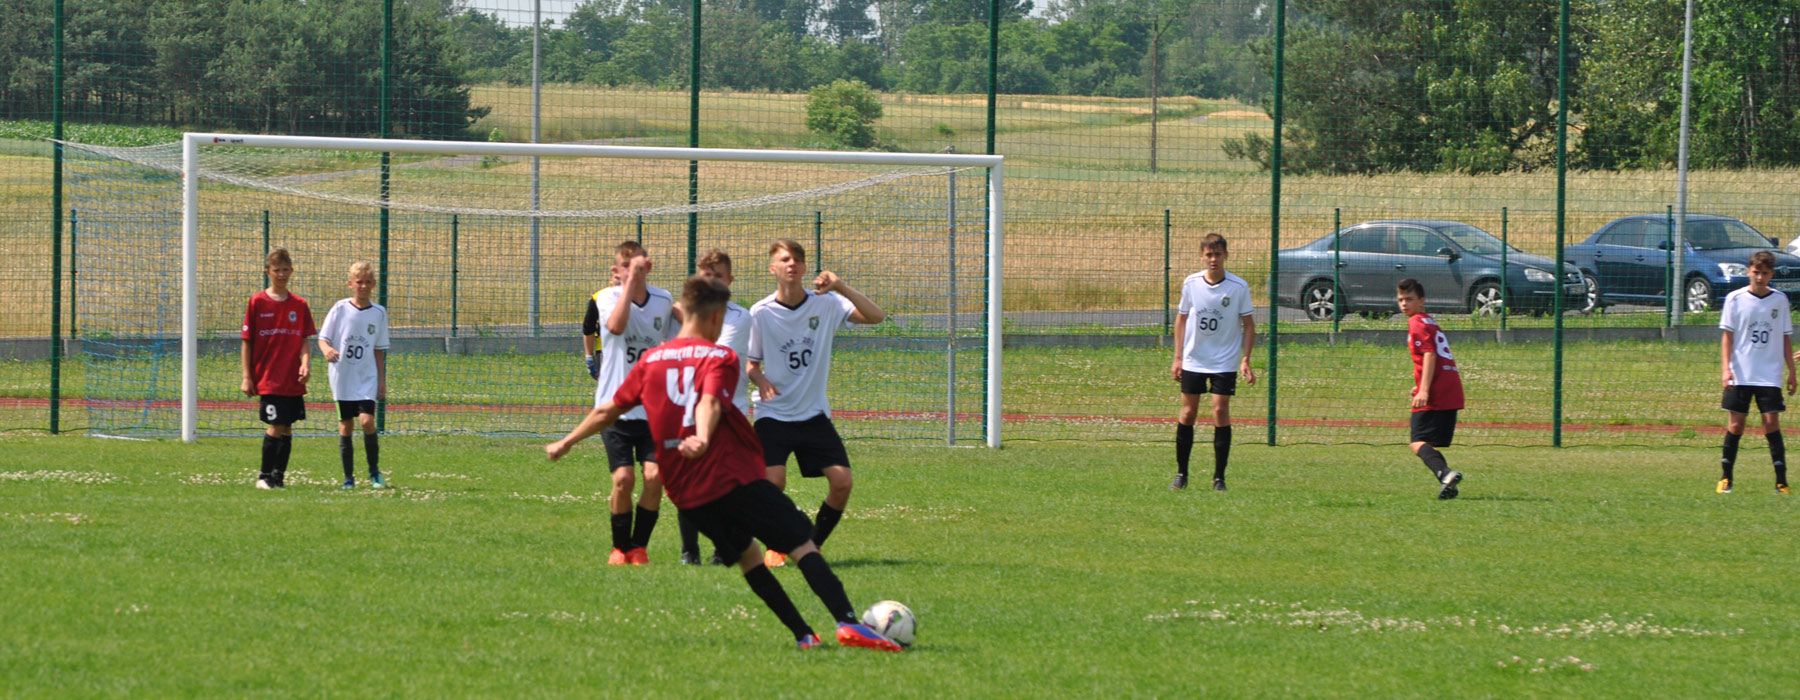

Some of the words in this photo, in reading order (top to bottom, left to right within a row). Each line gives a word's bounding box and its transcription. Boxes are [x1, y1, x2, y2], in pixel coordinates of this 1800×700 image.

[1199, 317, 1218, 331] 50
[1435, 330, 1453, 360] 8
[1751, 330, 1769, 344] 50
[346, 345, 363, 359] 50
[789, 348, 812, 370] 50
[666, 365, 699, 427] 4
[265, 404, 277, 421] 9
